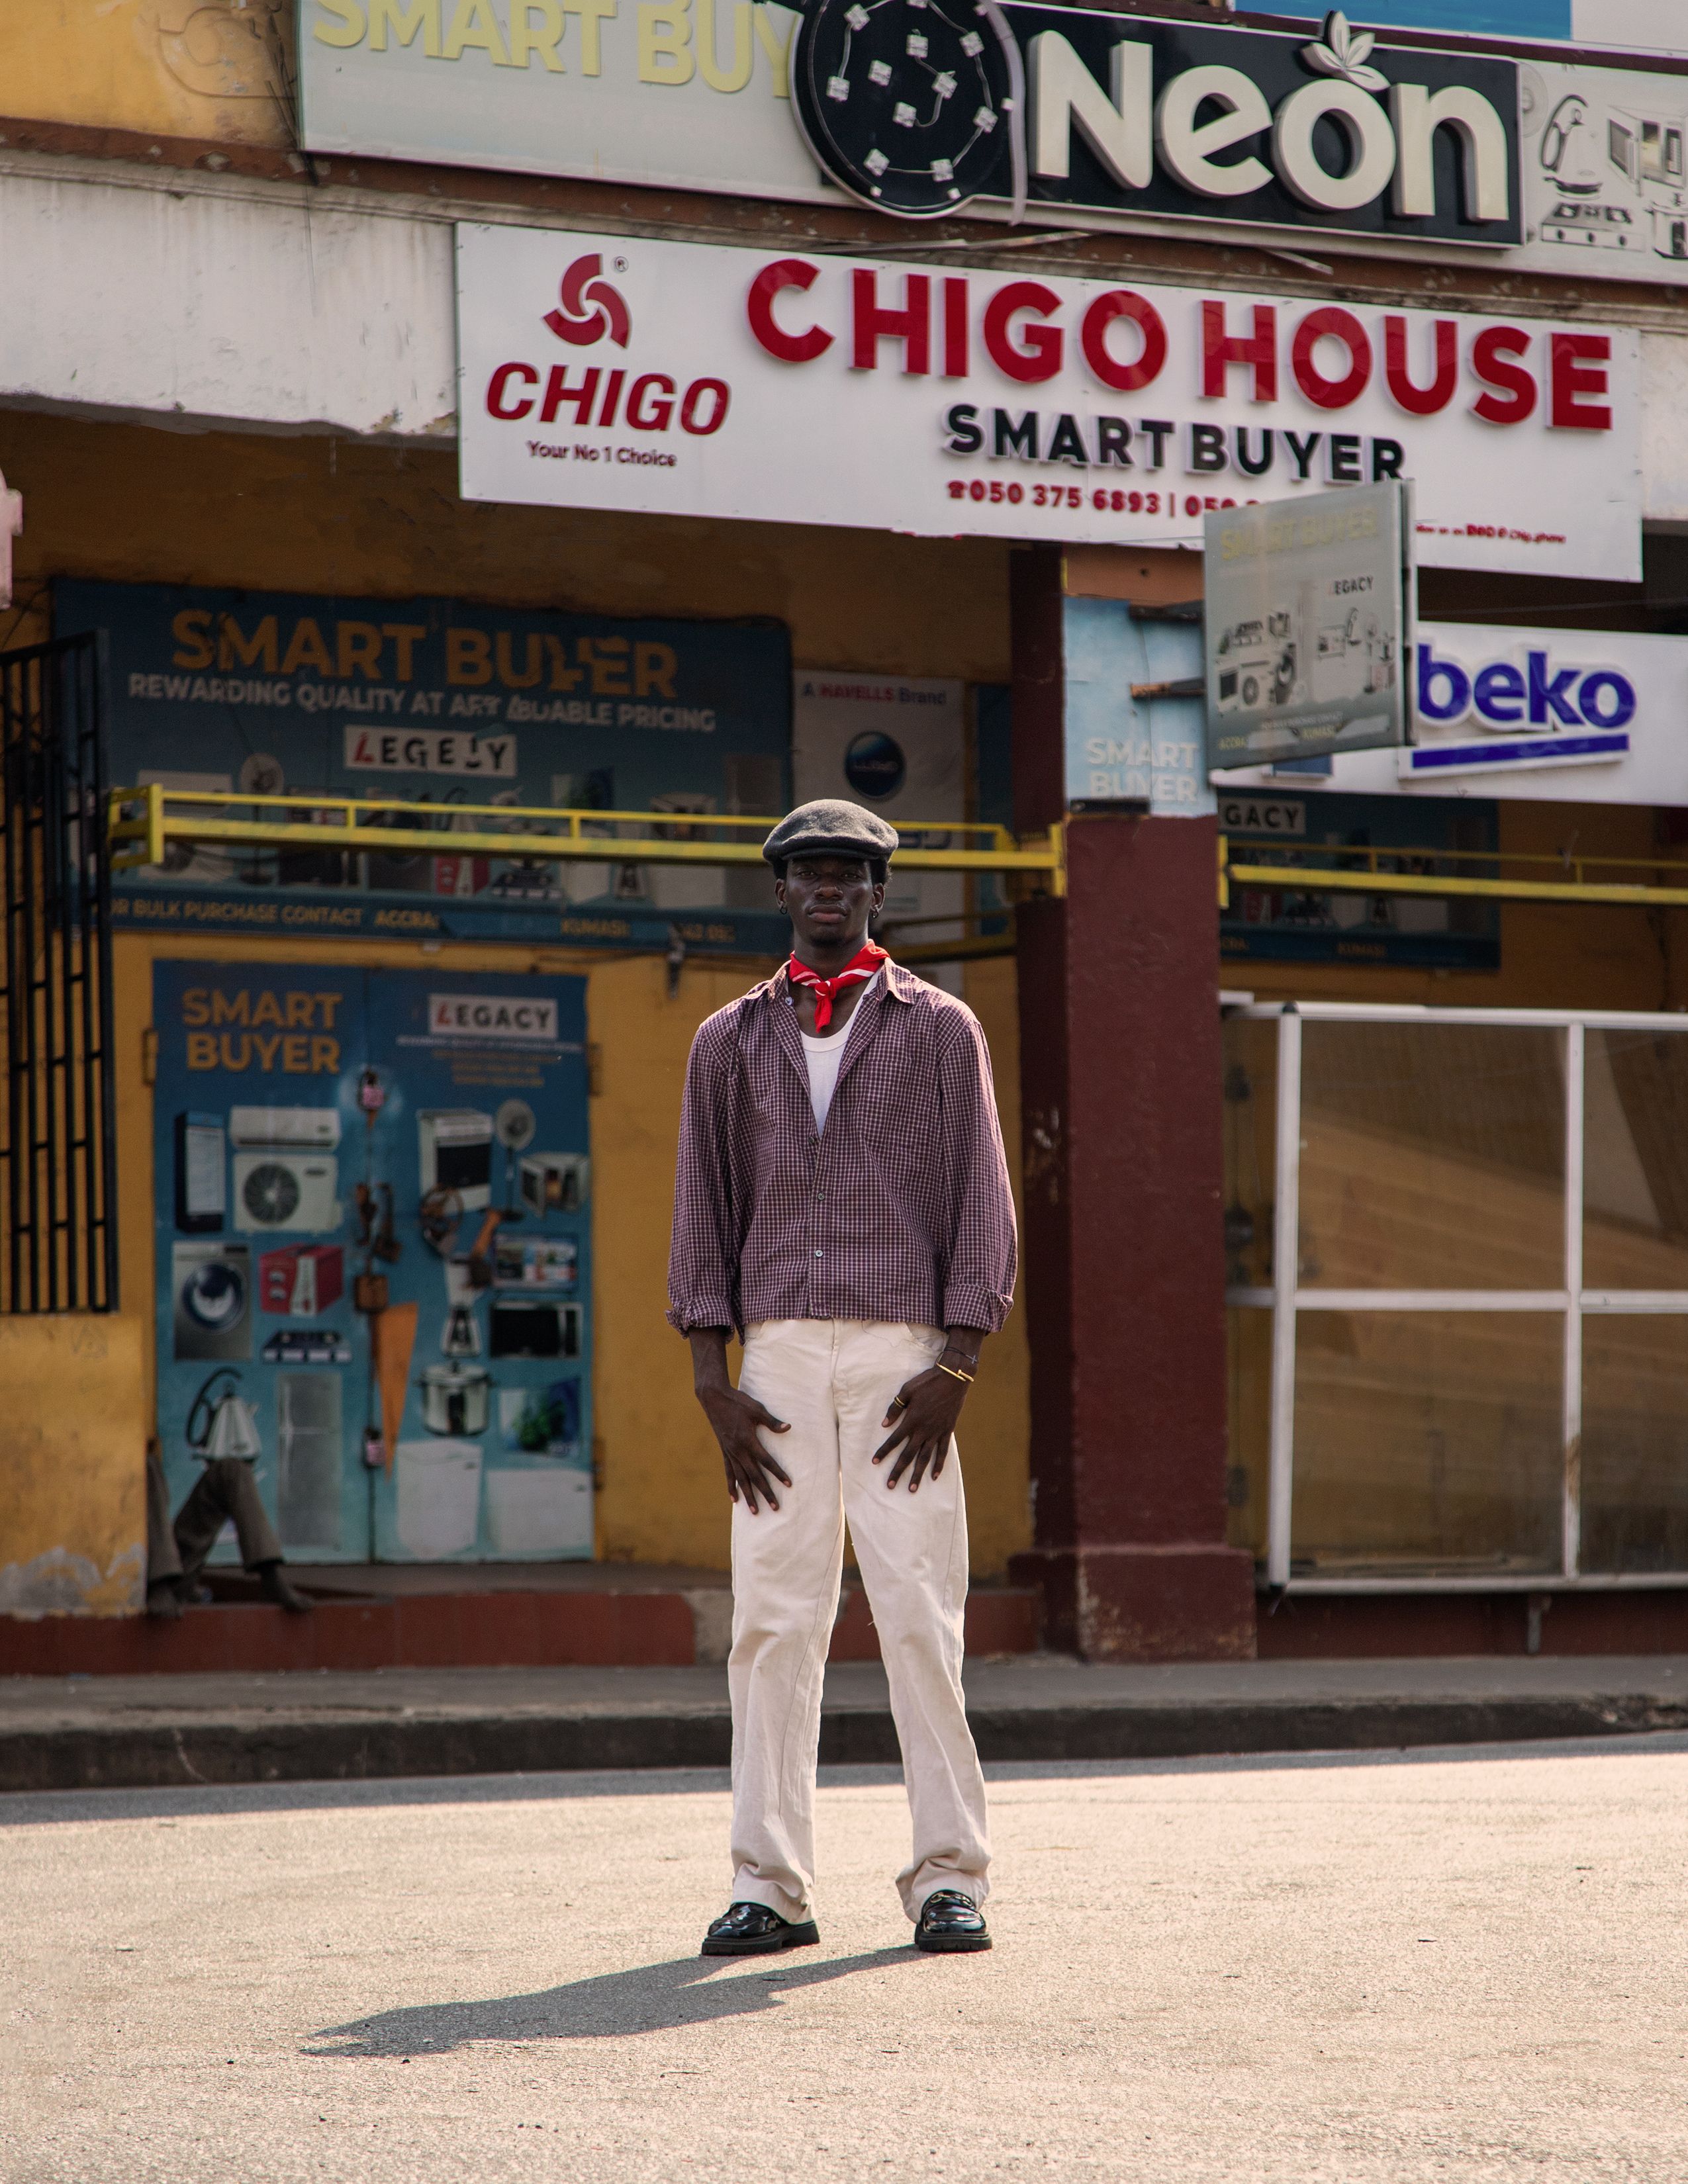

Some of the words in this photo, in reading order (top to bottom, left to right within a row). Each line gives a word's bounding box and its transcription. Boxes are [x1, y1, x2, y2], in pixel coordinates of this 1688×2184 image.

[313, 0, 617, 77] SMART
[1027, 29, 1509, 221] Neon
[746, 258, 1169, 392] CHIGO
[1199, 298, 1613, 431] HOUSE
[485, 361, 732, 435] CHIGO
[526, 439, 570, 459] Your
[573, 443, 599, 462] No
[603, 445, 612, 463] 1
[616, 447, 679, 467] Choice
[945, 403, 1175, 470] SMART
[1186, 422, 1405, 485] BUYER
[968, 478, 1025, 505] 050
[1033, 483, 1083, 509] 375
[1092, 487, 1161, 515] 6893
[171, 608, 426, 682] SMART
[127, 672, 291, 707] REWARDING
[295, 682, 407, 714] QUALITY
[410, 691, 445, 716] AT
[616, 702, 717, 733] PRICING
[1418, 643, 1637, 729] beko
[1086, 737, 1199, 769] SMART
[132, 899, 181, 920] BULK
[183, 900, 278, 925] PURCHASE
[280, 905, 363, 927] CONTACT
[181, 987, 344, 1030] SMART
[436, 1001, 551, 1031] LEGACY
[185, 1031, 341, 1074] BUYER
